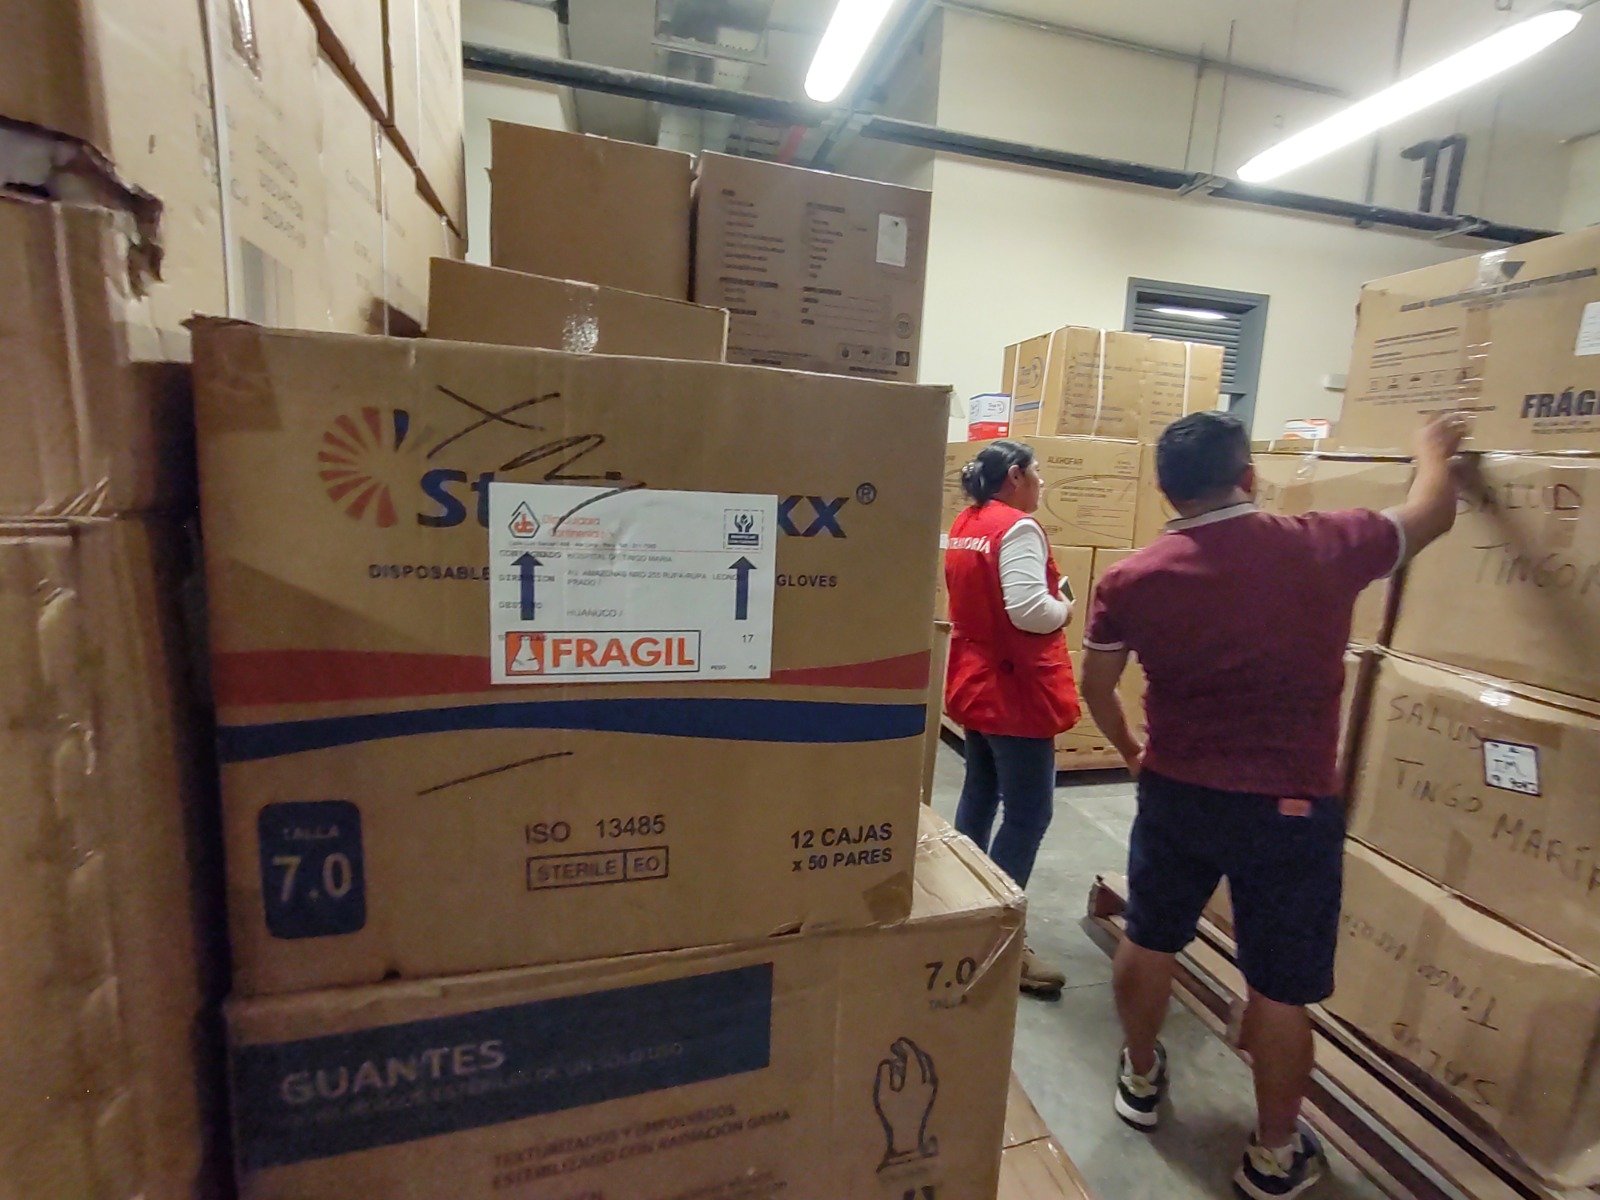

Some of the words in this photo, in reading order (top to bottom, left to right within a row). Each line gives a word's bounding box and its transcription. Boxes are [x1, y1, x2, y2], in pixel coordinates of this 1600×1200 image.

[776, 574, 838, 588] GLOVES
[551, 636, 695, 668] FRAGIL
[742, 634, 754, 643] 17
[525, 820, 572, 845] ISO
[596, 813, 667, 839] 13485
[790, 829, 815, 850] 12
[821, 822, 893, 847] CAJAS
[536, 859, 618, 882] STERILE
[633, 855, 660, 873] EO
[808, 854, 828, 871] 50
[833, 847, 893, 867] PARES
[272, 851, 353, 903] 7.0
[925, 956, 977, 991] 7.0
[280, 1039, 506, 1106] GUANTES
